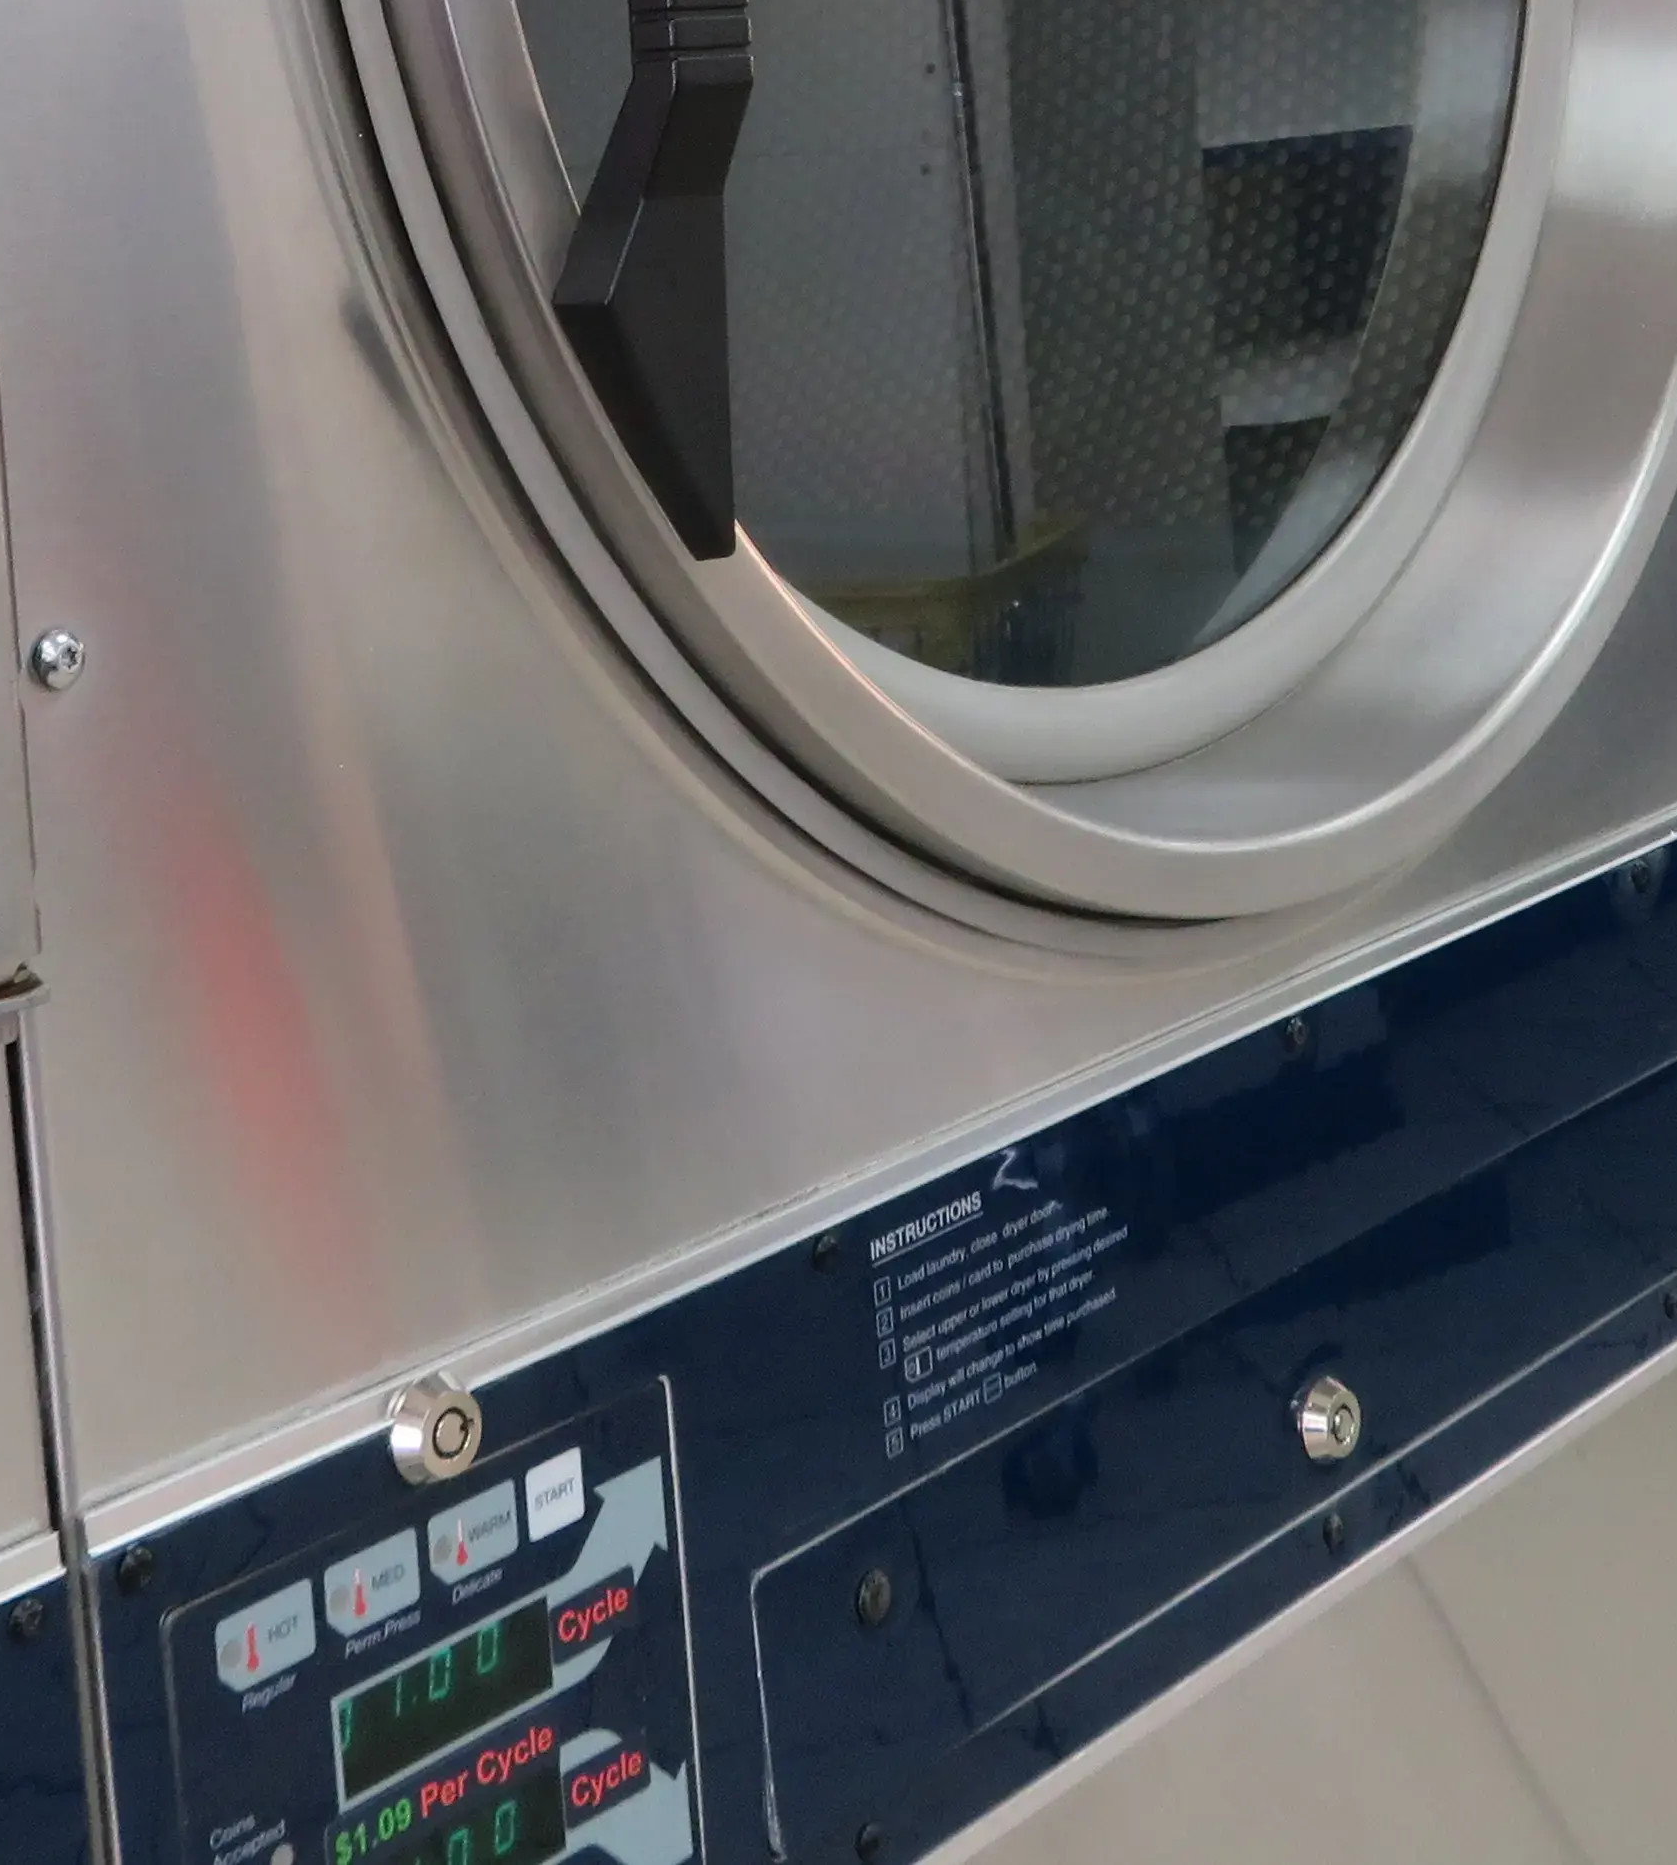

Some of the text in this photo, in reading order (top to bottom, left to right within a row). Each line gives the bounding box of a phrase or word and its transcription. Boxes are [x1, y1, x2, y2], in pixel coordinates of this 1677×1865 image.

[869, 1190, 982, 1261] INSTRUCTIONS
[898, 1266, 925, 1291] Load
[970, 1231, 999, 1254] close
[1002, 1218, 1029, 1240] dryer
[900, 1294, 931, 1322] Insert
[932, 1281, 961, 1304] coins
[968, 1266, 993, 1292] card
[993, 1259, 1004, 1275] to
[1007, 1233, 1054, 1271] purchase
[1053, 1216, 1086, 1245] drying
[903, 1323, 936, 1353] Select
[937, 1309, 968, 1340] upper
[968, 1301, 981, 1319] or
[980, 1288, 1009, 1312] lower
[1010, 1275, 1036, 1298] dryer
[1035, 1263, 1052, 1284] by
[1051, 1245, 1093, 1279] pressing
[1092, 1224, 1129, 1255] desired
[935, 1320, 999, 1362] temperature
[999, 1301, 1034, 1328] setting
[1033, 1290, 1048, 1311] for
[1048, 1278, 1068, 1304] that
[907, 1377, 948, 1411] Display
[948, 1366, 966, 1389] will
[965, 1349, 1005, 1379] change
[1004, 1338, 1017, 1355] to
[1017, 1328, 1043, 1352] show
[1043, 1313, 1066, 1335] time
[910, 1415, 942, 1441] Press
[942, 1388, 982, 1421] START
[533, 1476, 578, 1514] START
[468, 1510, 512, 1544] WARM
[370, 1564, 407, 1592] MED
[451, 1566, 506, 1607] Delicate
[266, 1613, 300, 1643] HOT
[557, 1584, 632, 1647] Cycle
[241, 1673, 297, 1715] Regular
[334, 1724, 556, 1865] $1.09 Per Cycle
[570, 1748, 644, 1810] Cycle
